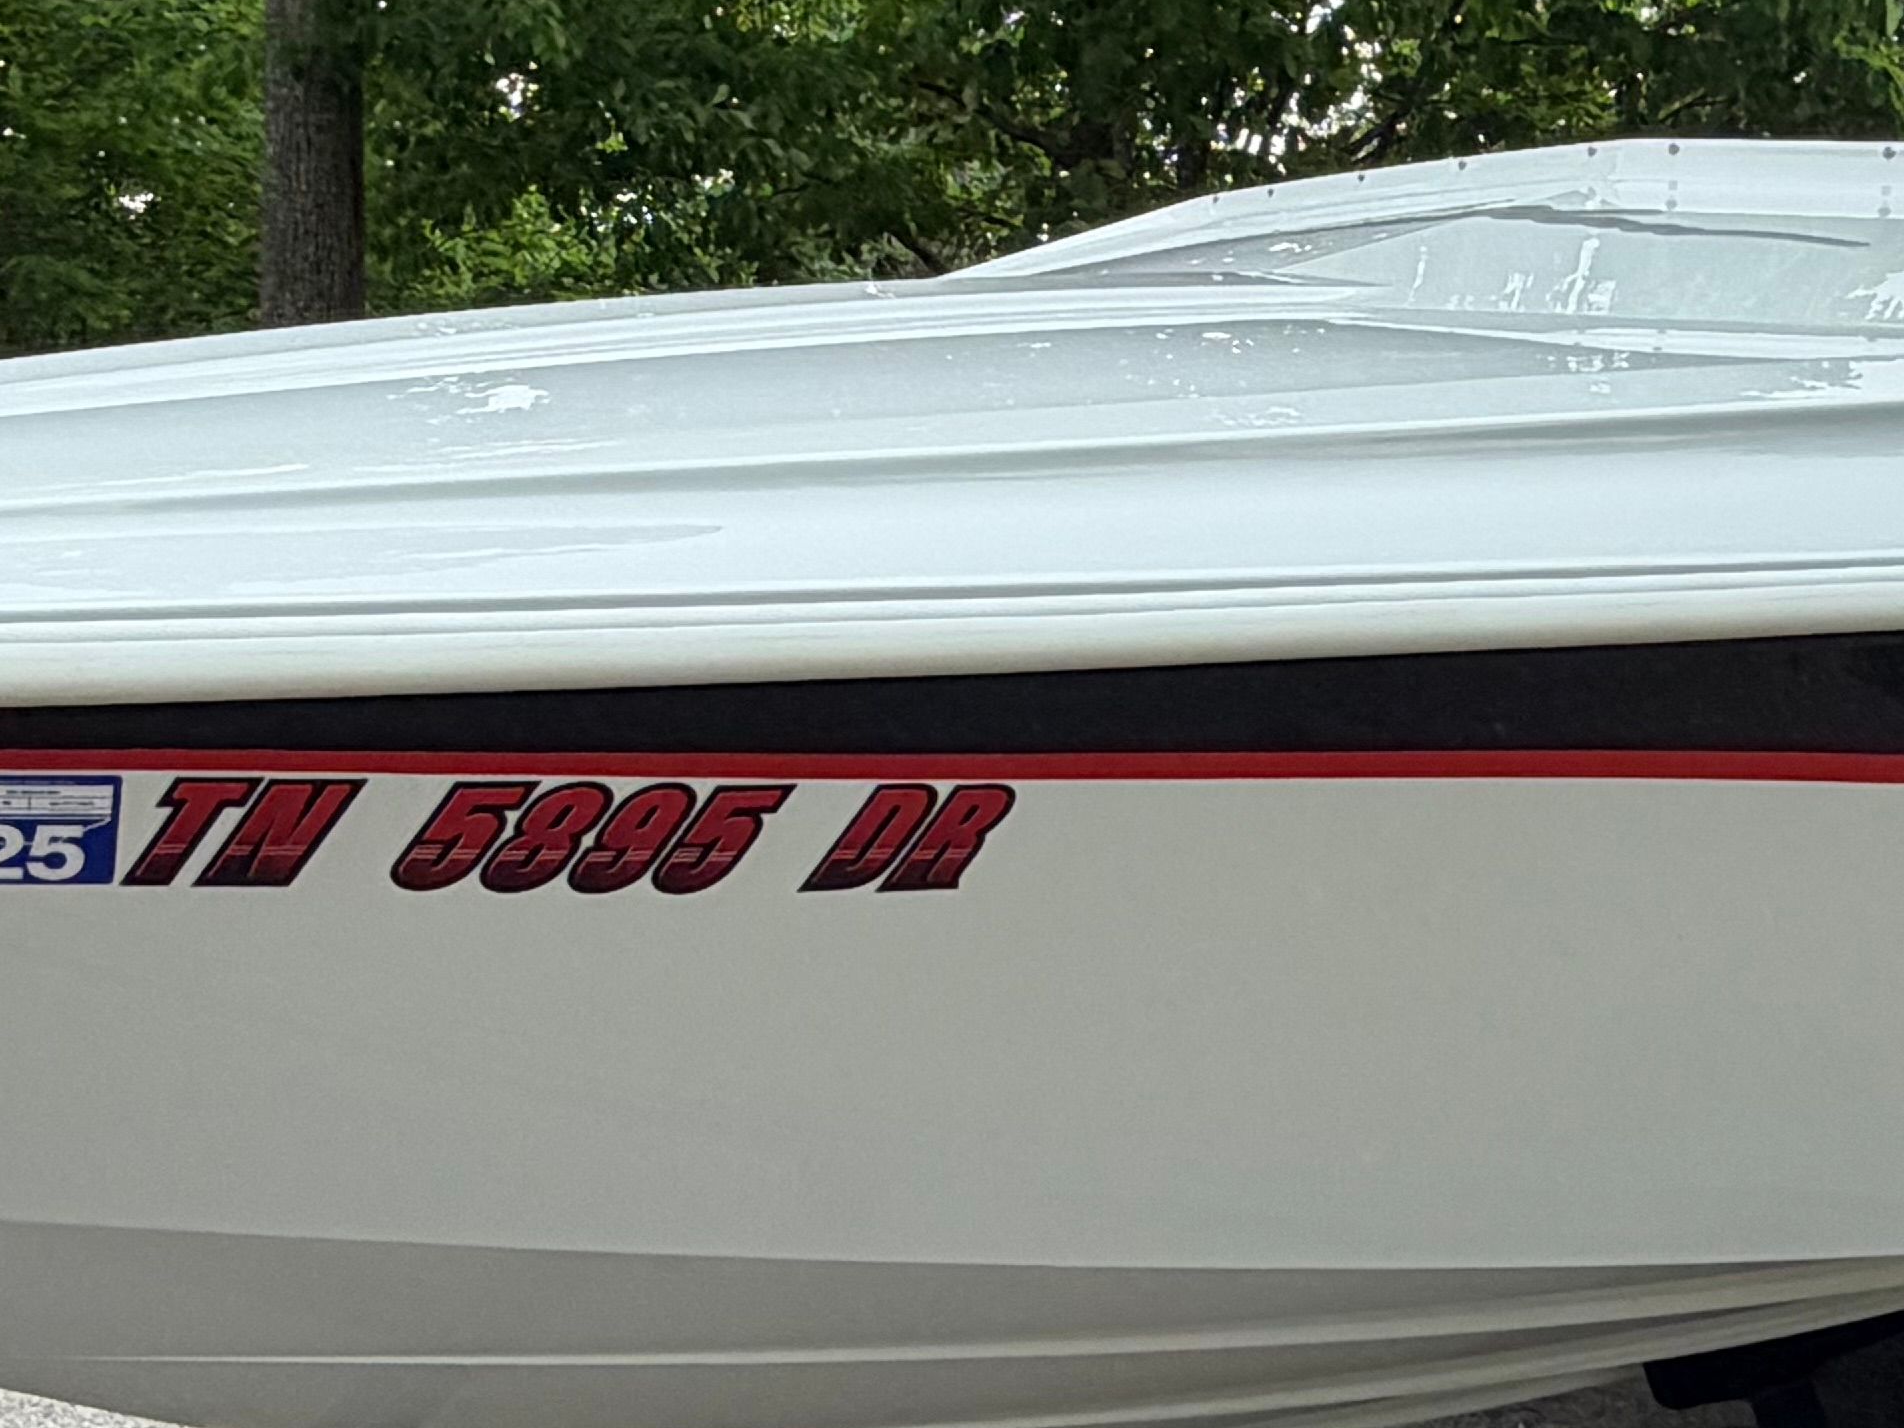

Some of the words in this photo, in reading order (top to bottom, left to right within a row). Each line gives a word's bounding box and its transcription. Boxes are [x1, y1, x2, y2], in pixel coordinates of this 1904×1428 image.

[119, 777, 369, 888] TN
[390, 780, 798, 895] 5895
[797, 783, 1016, 893] DR
